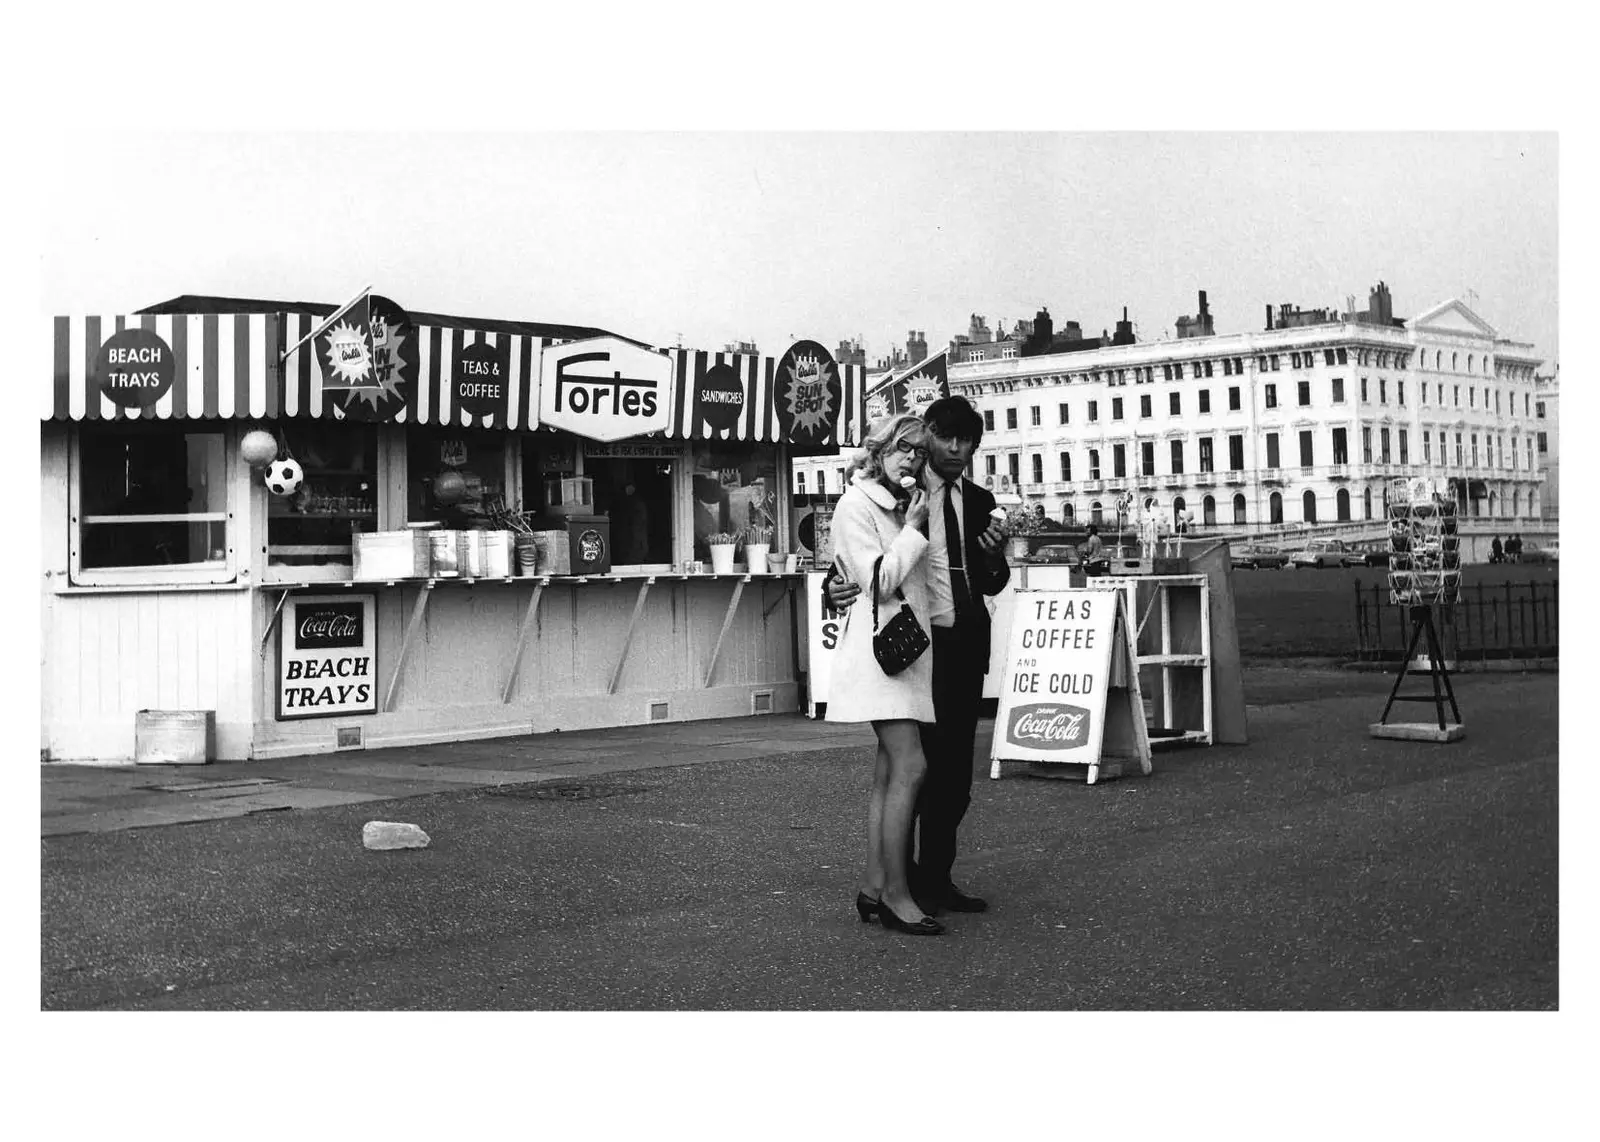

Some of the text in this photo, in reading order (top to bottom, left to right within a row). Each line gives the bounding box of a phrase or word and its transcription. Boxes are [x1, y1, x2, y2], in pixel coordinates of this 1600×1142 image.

[108, 347, 162, 364] BEACH
[461, 360, 500, 376] TEAS &
[108, 372, 160, 388] TRAYS
[554, 351, 658, 418] Fortes
[459, 382, 500, 399] COFFEE
[700, 389, 743, 405] SANDWICHES
[796, 382, 823, 400] SUN
[795, 396, 826, 415] SPOT
[1035, 600, 1092, 620] TEAS
[1022, 628, 1096, 649] COFFEE
[286, 657, 370, 680] BEACH
[1016, 658, 1037, 668] AND
[1013, 673, 1094, 694] ICE COLD
[284, 683, 371, 707] TRAYS
